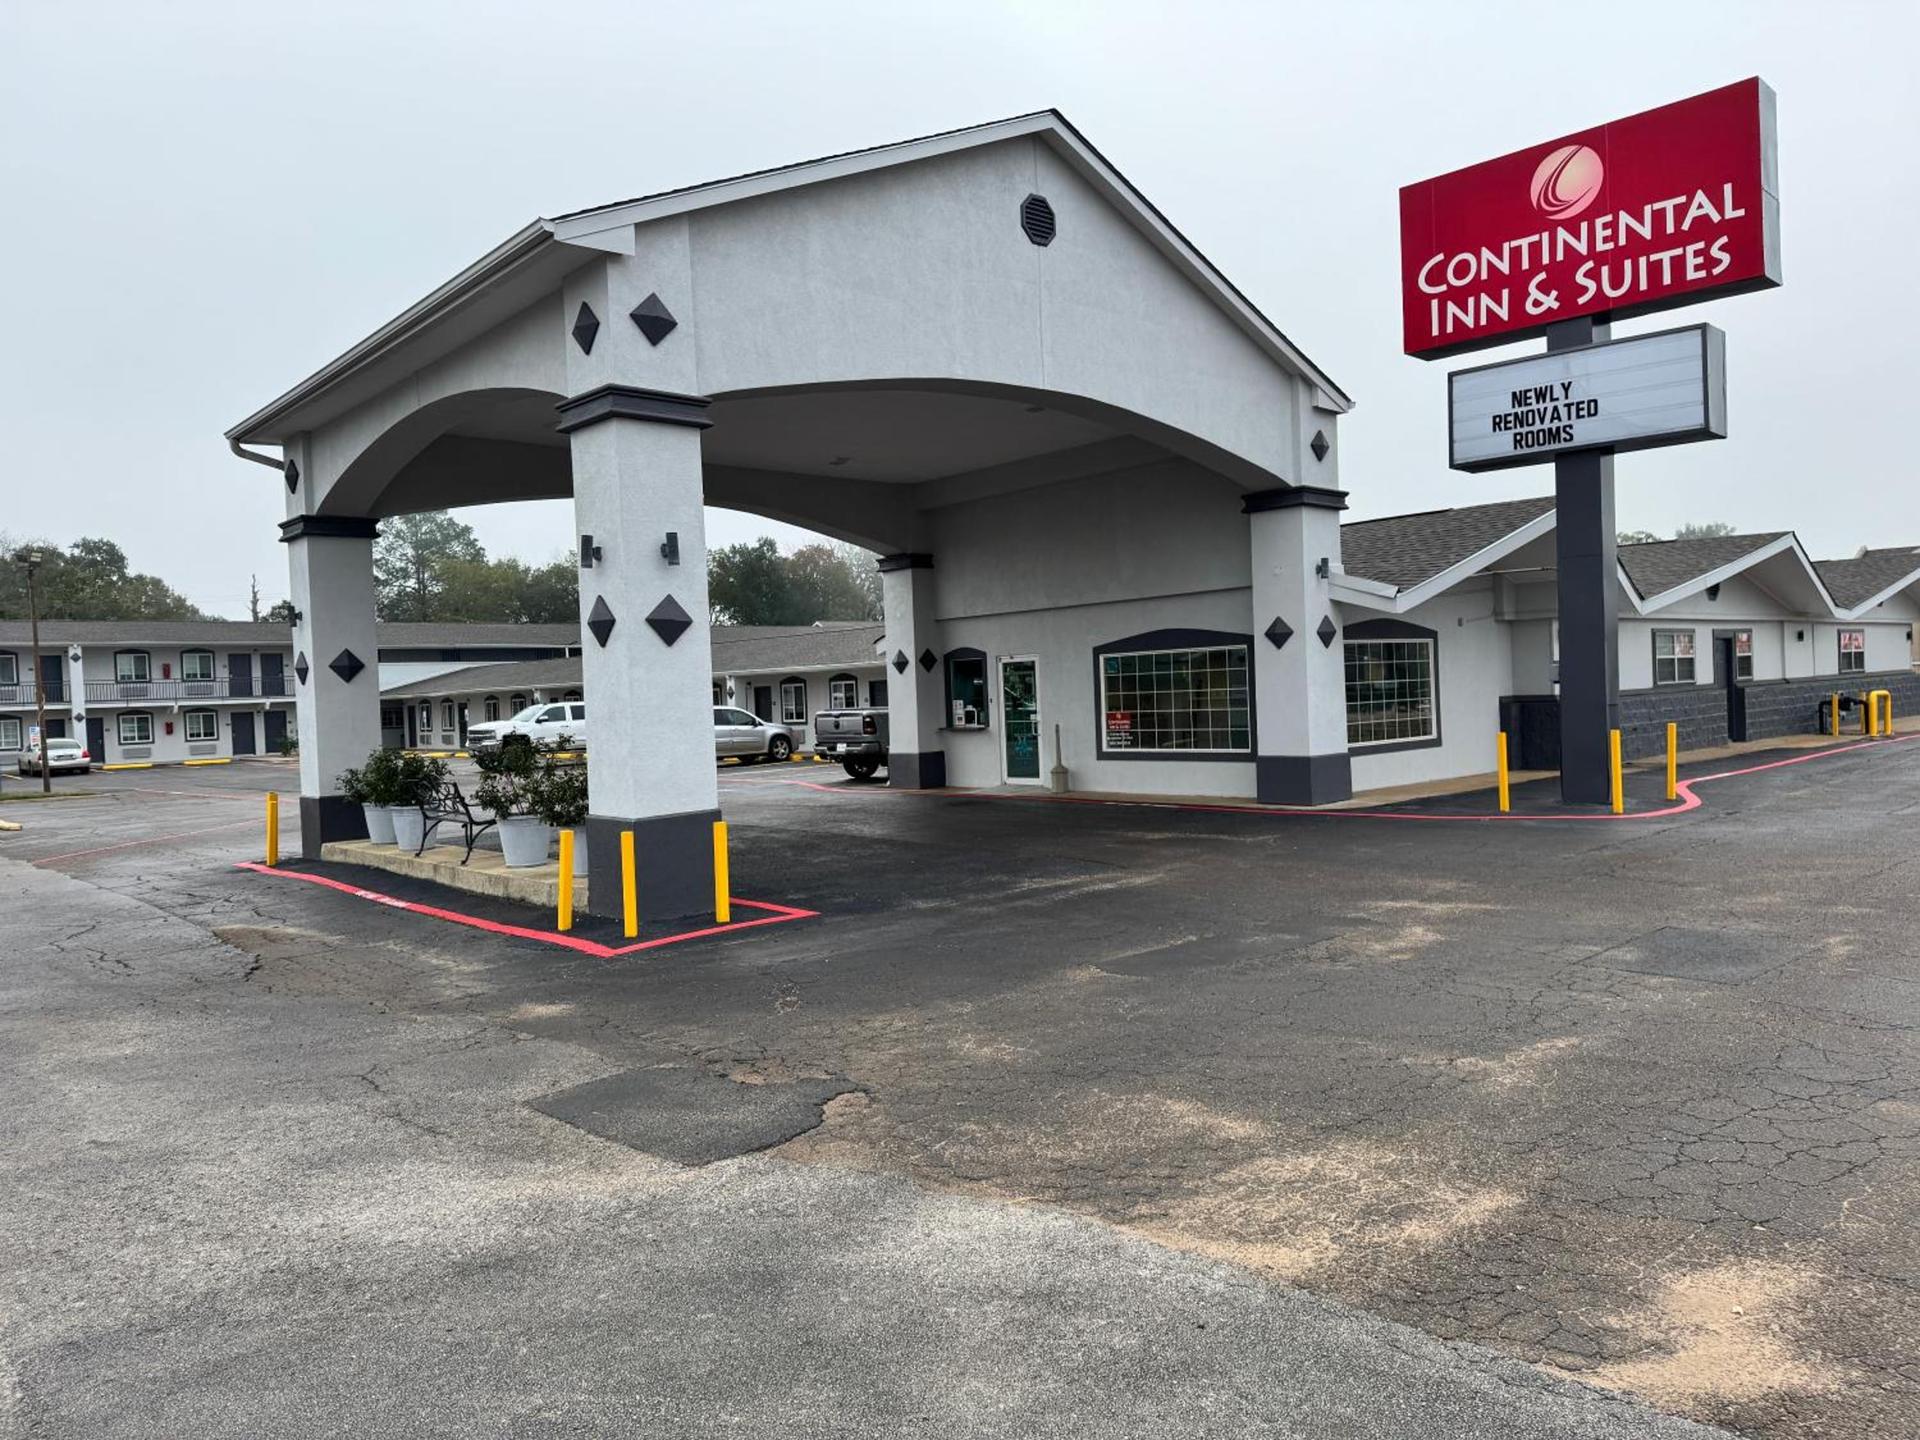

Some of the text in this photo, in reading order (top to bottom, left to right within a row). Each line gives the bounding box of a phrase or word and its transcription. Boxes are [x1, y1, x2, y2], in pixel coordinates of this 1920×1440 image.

[1417, 182, 1746, 295] CONTINENTAL
[1431, 235, 1732, 337] INN & SUITES
[1511, 381, 1573, 409] NEWLY
[1492, 398, 1599, 433] RENOVATED
[1513, 423, 1574, 450] ROOMS
